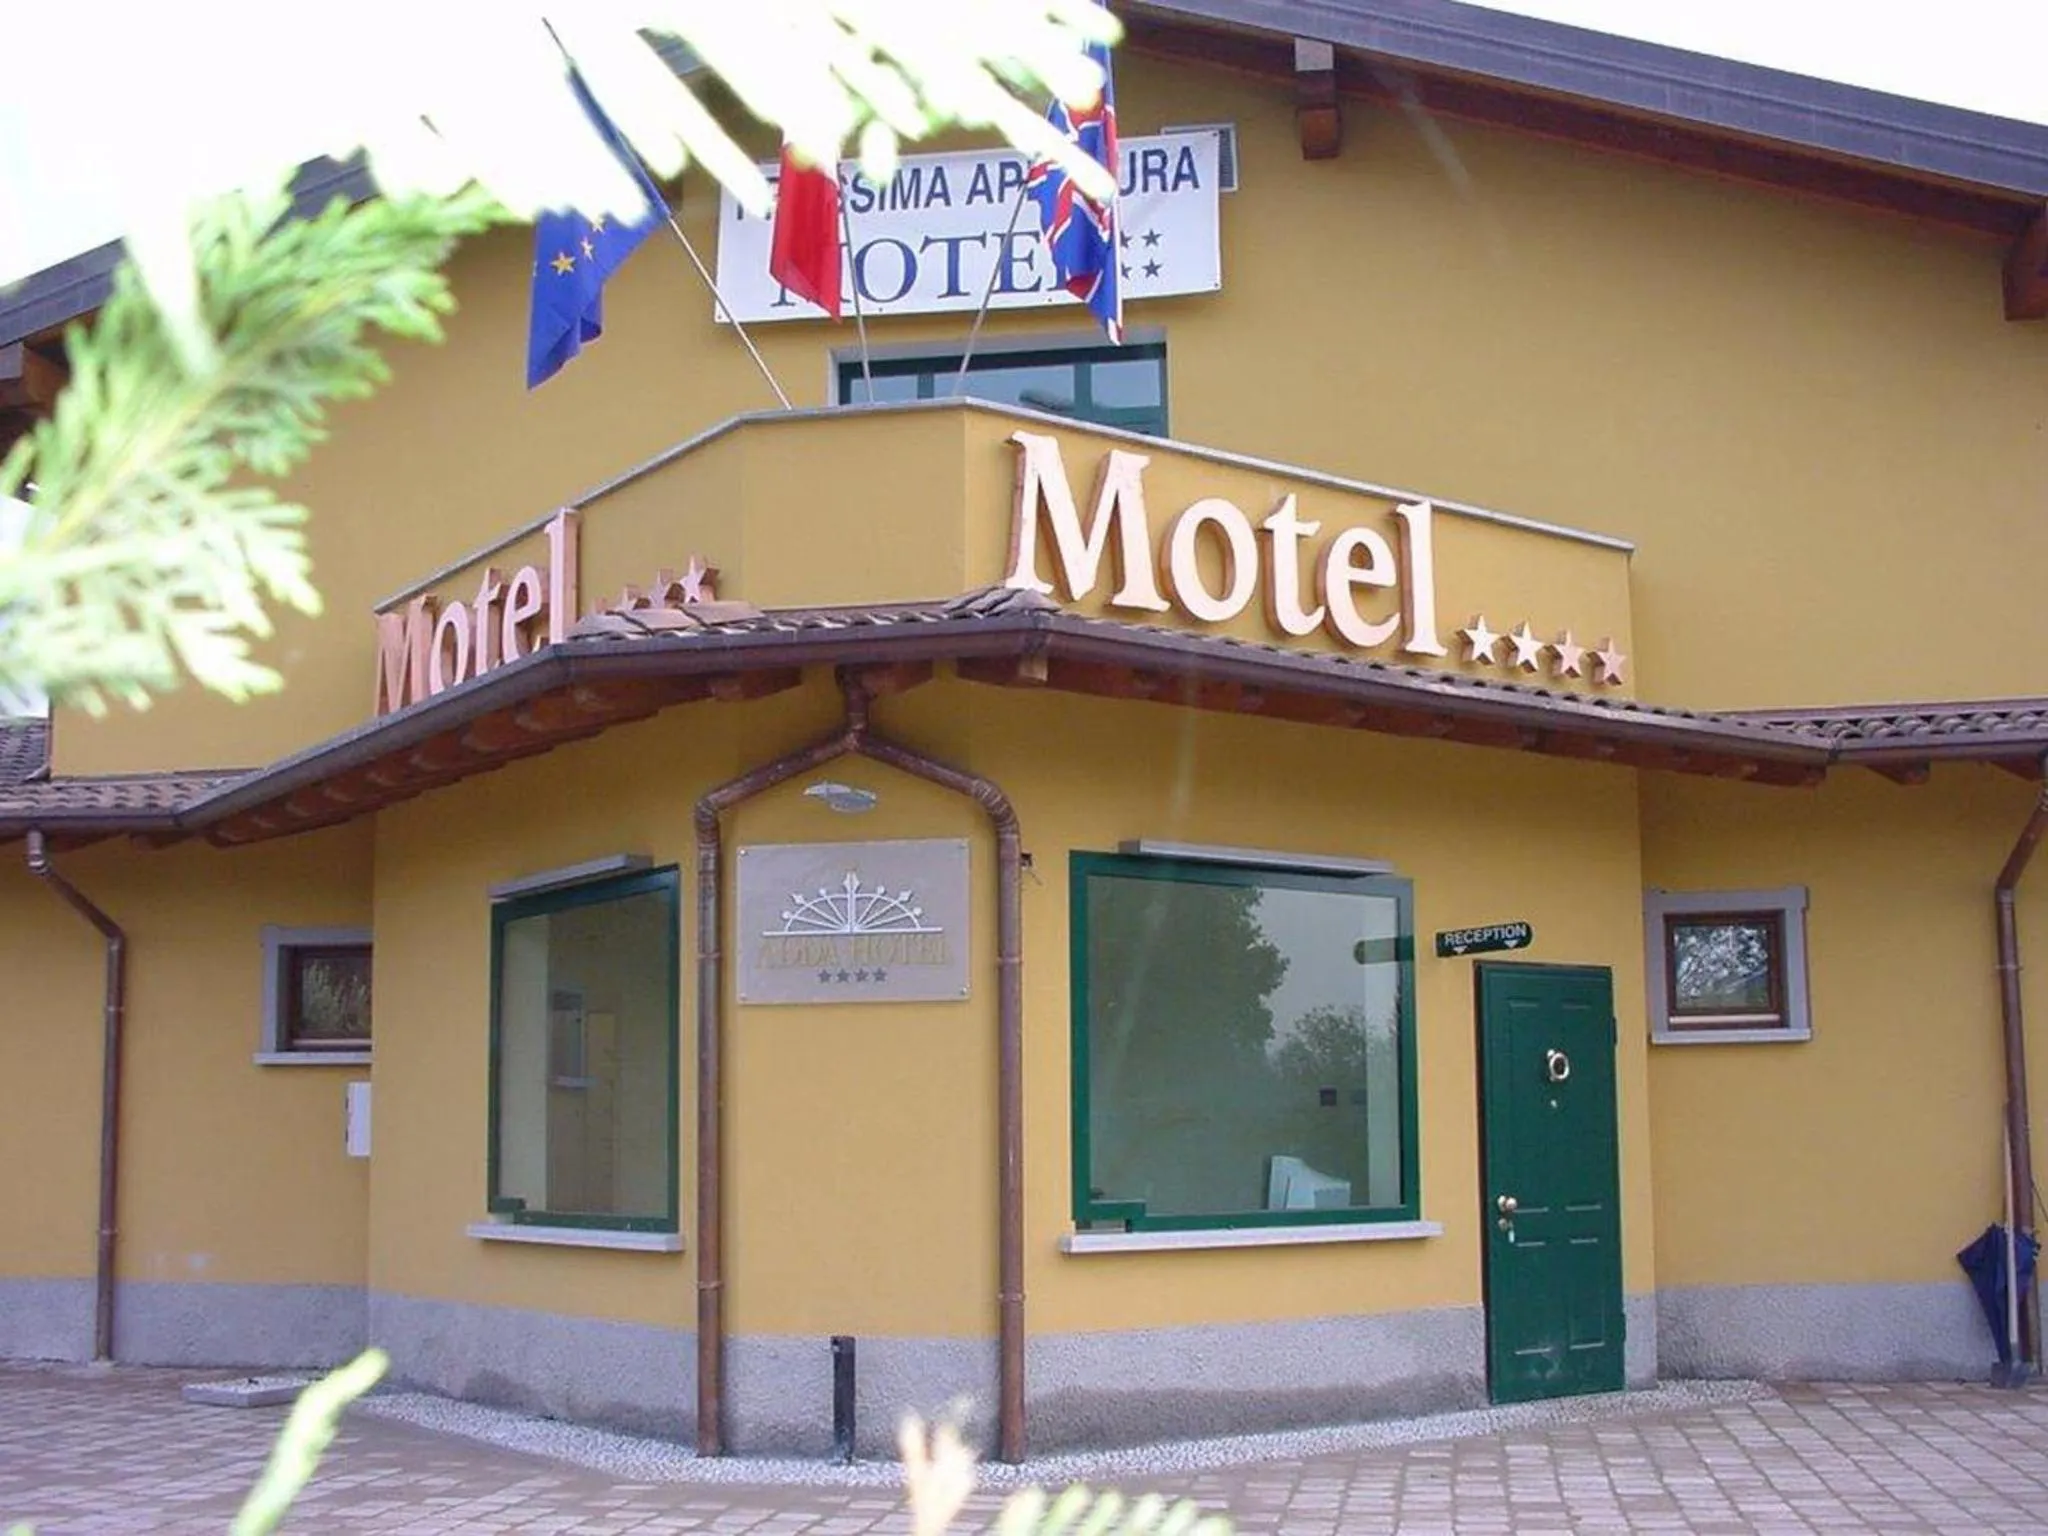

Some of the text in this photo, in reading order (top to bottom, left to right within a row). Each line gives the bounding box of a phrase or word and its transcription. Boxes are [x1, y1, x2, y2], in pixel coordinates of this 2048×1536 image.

[965, 145, 1200, 205] APURA
[1003, 430, 1448, 657] Motel
[374, 507, 580, 717] Motel
[1444, 924, 1527, 946] RECEPTION
